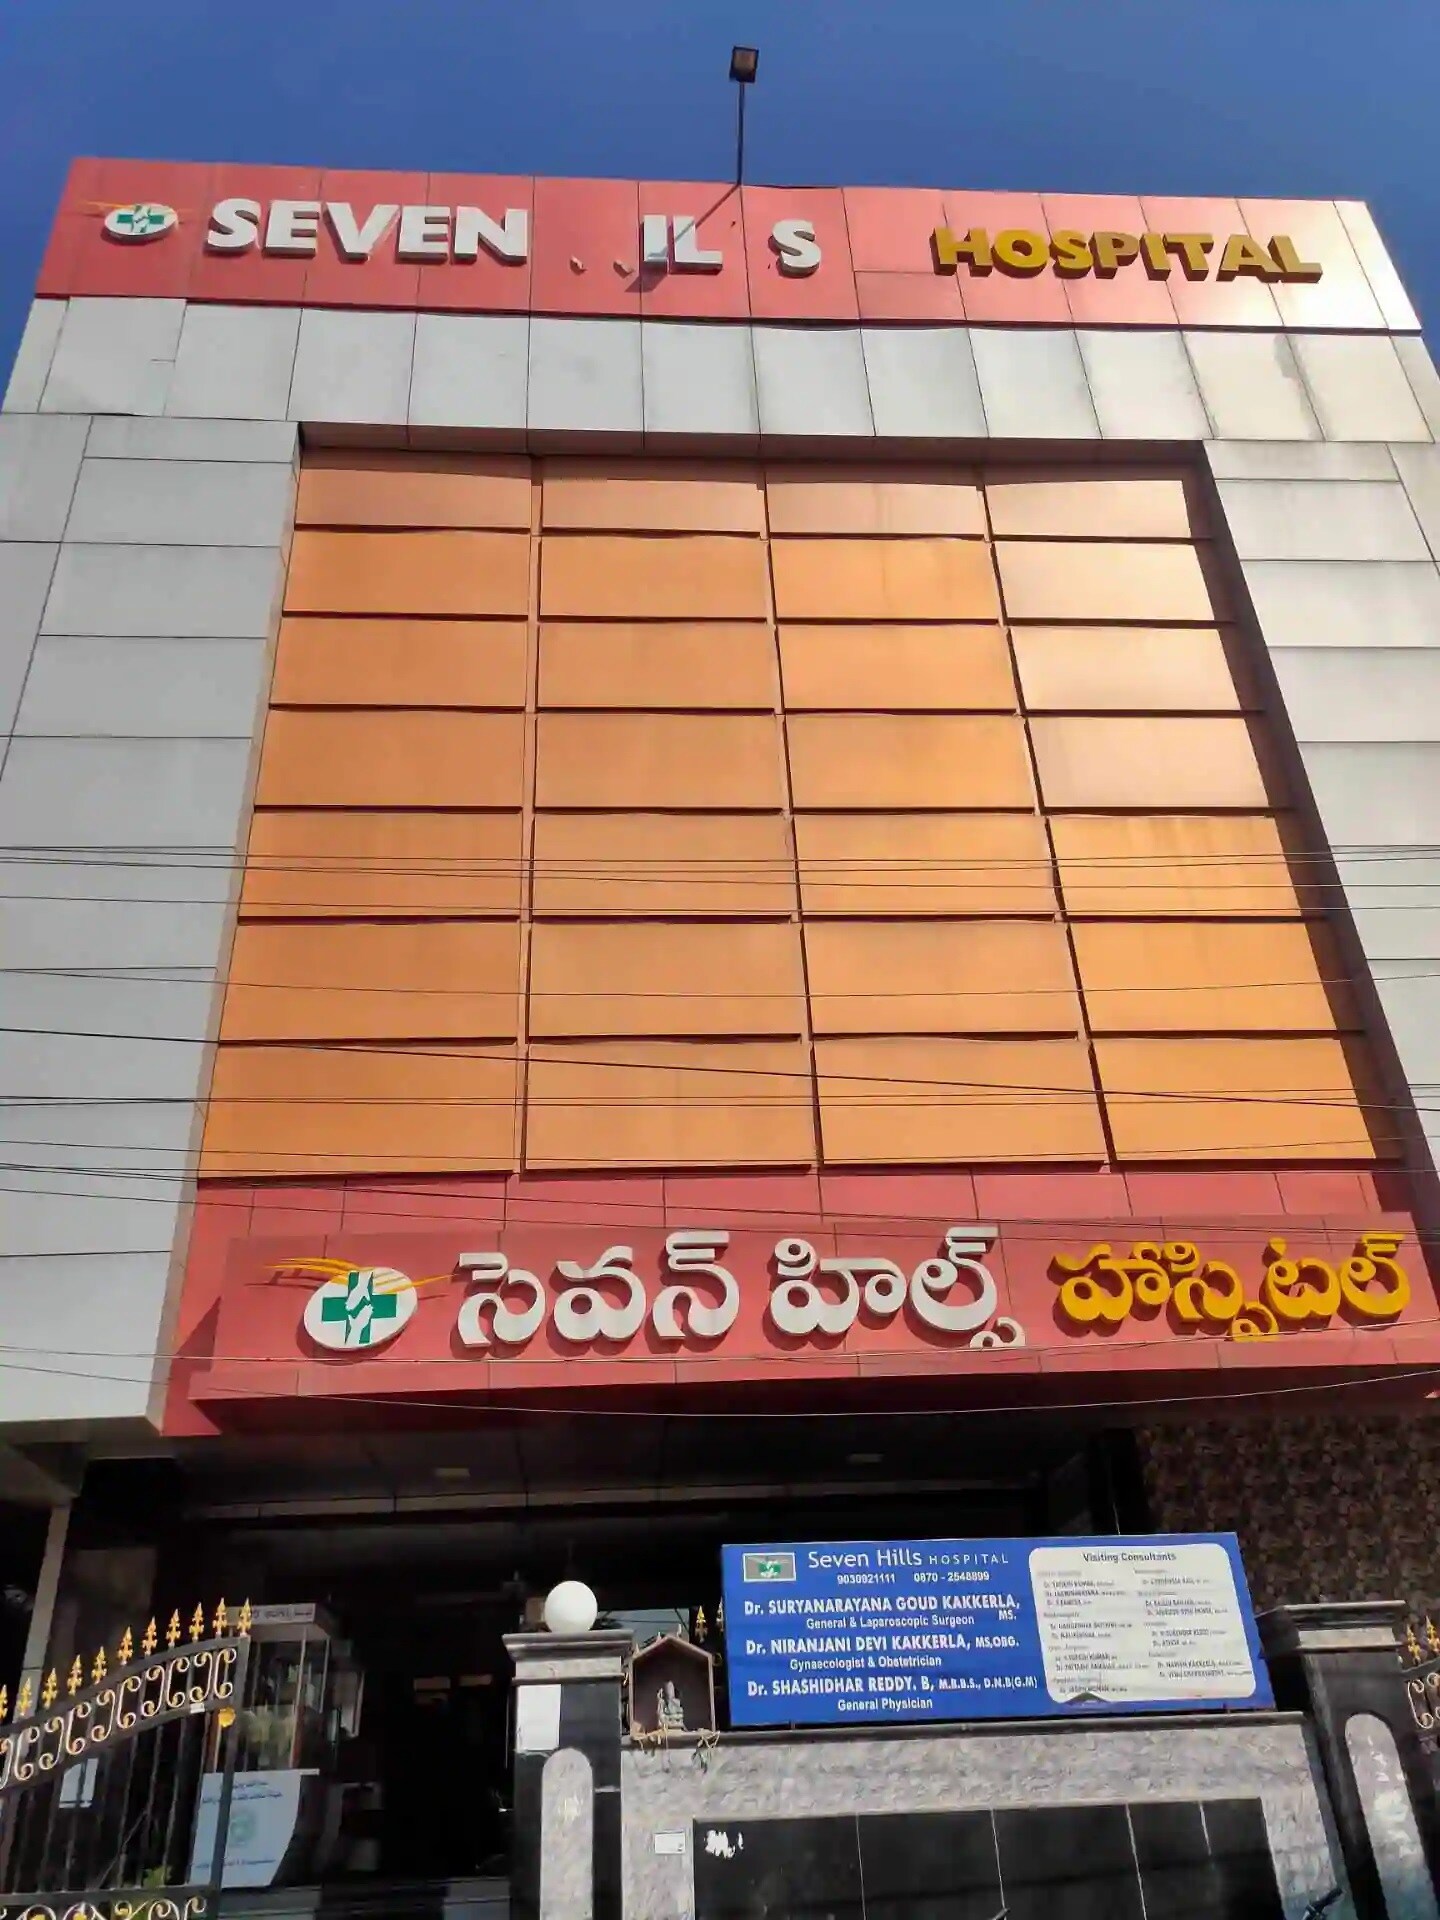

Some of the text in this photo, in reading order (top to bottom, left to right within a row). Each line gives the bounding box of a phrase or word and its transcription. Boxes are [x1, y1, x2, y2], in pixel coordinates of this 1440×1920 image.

[205, 197, 529, 263] SEVEN
[930, 225, 1324, 285] HOSPITAL
[457, 1226, 1412, 1349] సెవన్ హిల్స్ హాస్పిటల్
[808, 1547, 1009, 1569] Seven Hills HOSPITAL
[1083, 1552, 1177, 1564] Visiting Consultants
[744, 1592, 1020, 1616] Dr. SURYANARAYANA GOUD KAKKERLA,
[806, 1613, 975, 1630] General & Laparoscopic Surgeon
[998, 1609, 1017, 1622] MS.
[746, 1639, 767, 1656] Dr.
[770, 1636, 852, 1655] NIRANJANI
[855, 1635, 888, 1652] DEVI
[891, 1633, 971, 1651] KAKKERLA,
[789, 1654, 943, 1673] Gynaecologist & Obstetrician
[747, 1680, 768, 1697] Dr.
[771, 1677, 864, 1696] SHASHIDHAR
[837, 1697, 934, 1713] General Physician
